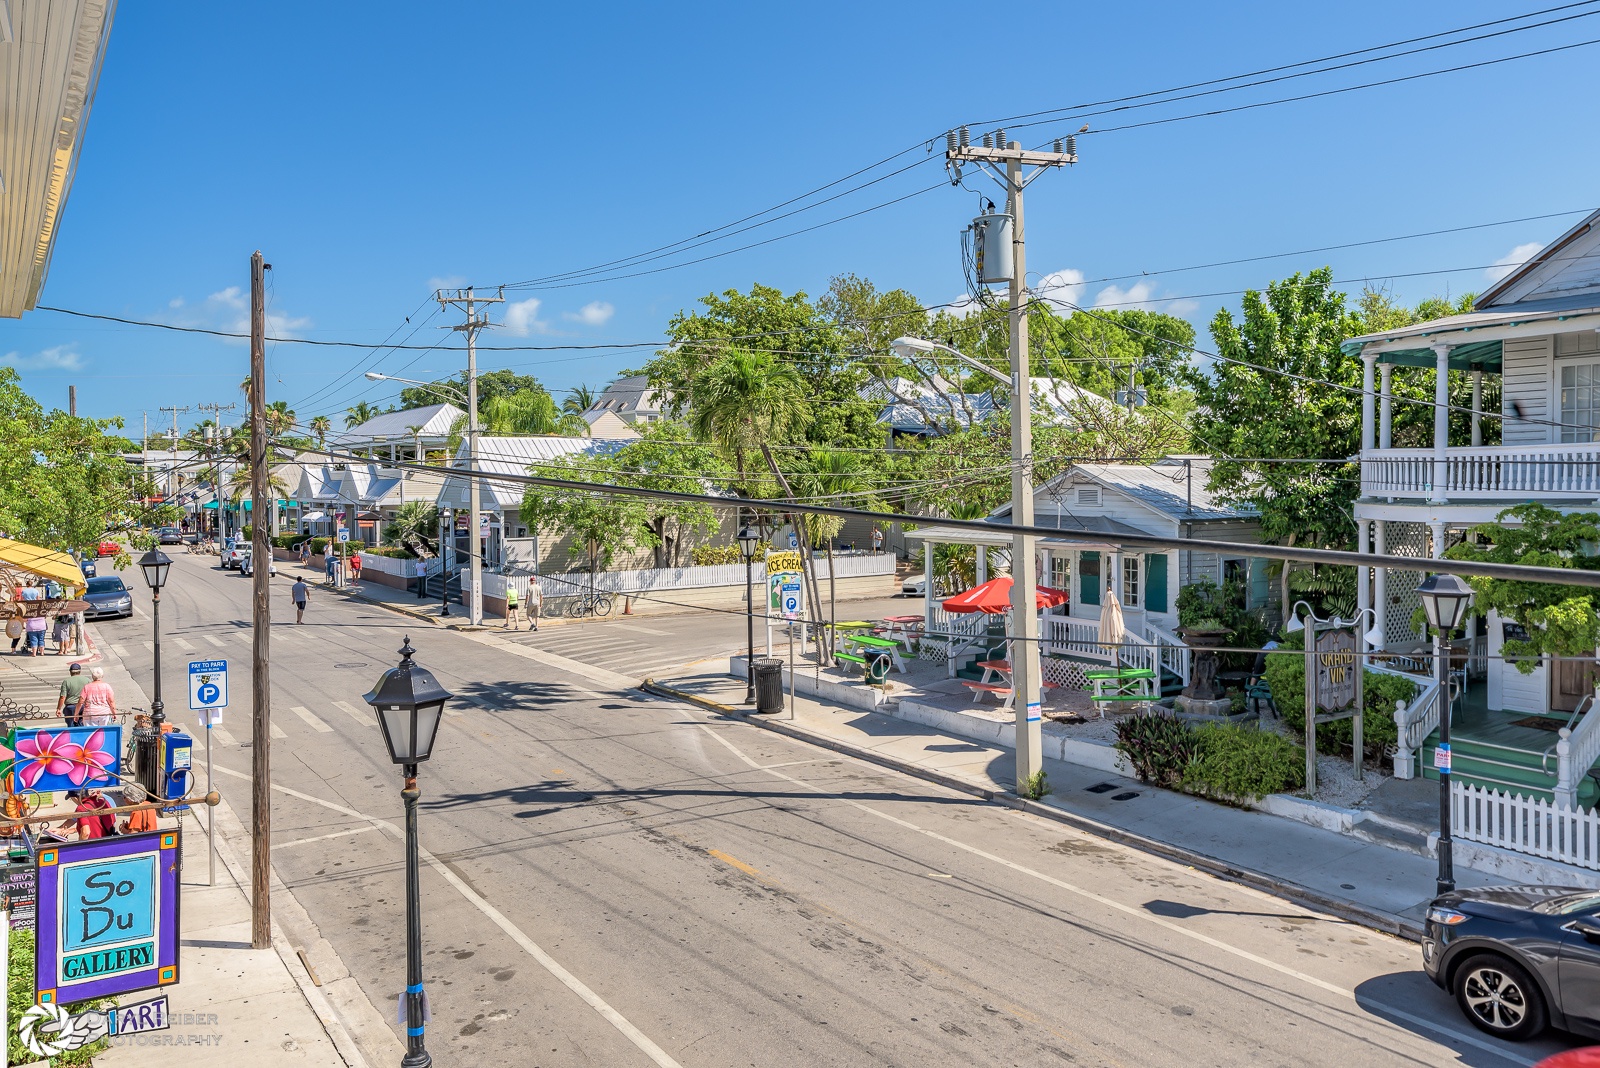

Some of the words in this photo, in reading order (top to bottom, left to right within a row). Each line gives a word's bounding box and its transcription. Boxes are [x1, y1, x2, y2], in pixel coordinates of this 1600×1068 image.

[768, 560, 780, 573] ICE
[1320, 648, 1354, 667] GRAND
[1329, 667, 1345, 683] VIN
[204, 688, 216, 700] P
[81, 871, 135, 906] So
[80, 907, 134, 942] Du
[63, 945, 153, 978] GALLERY
[120, 1001, 165, 1032] ART
